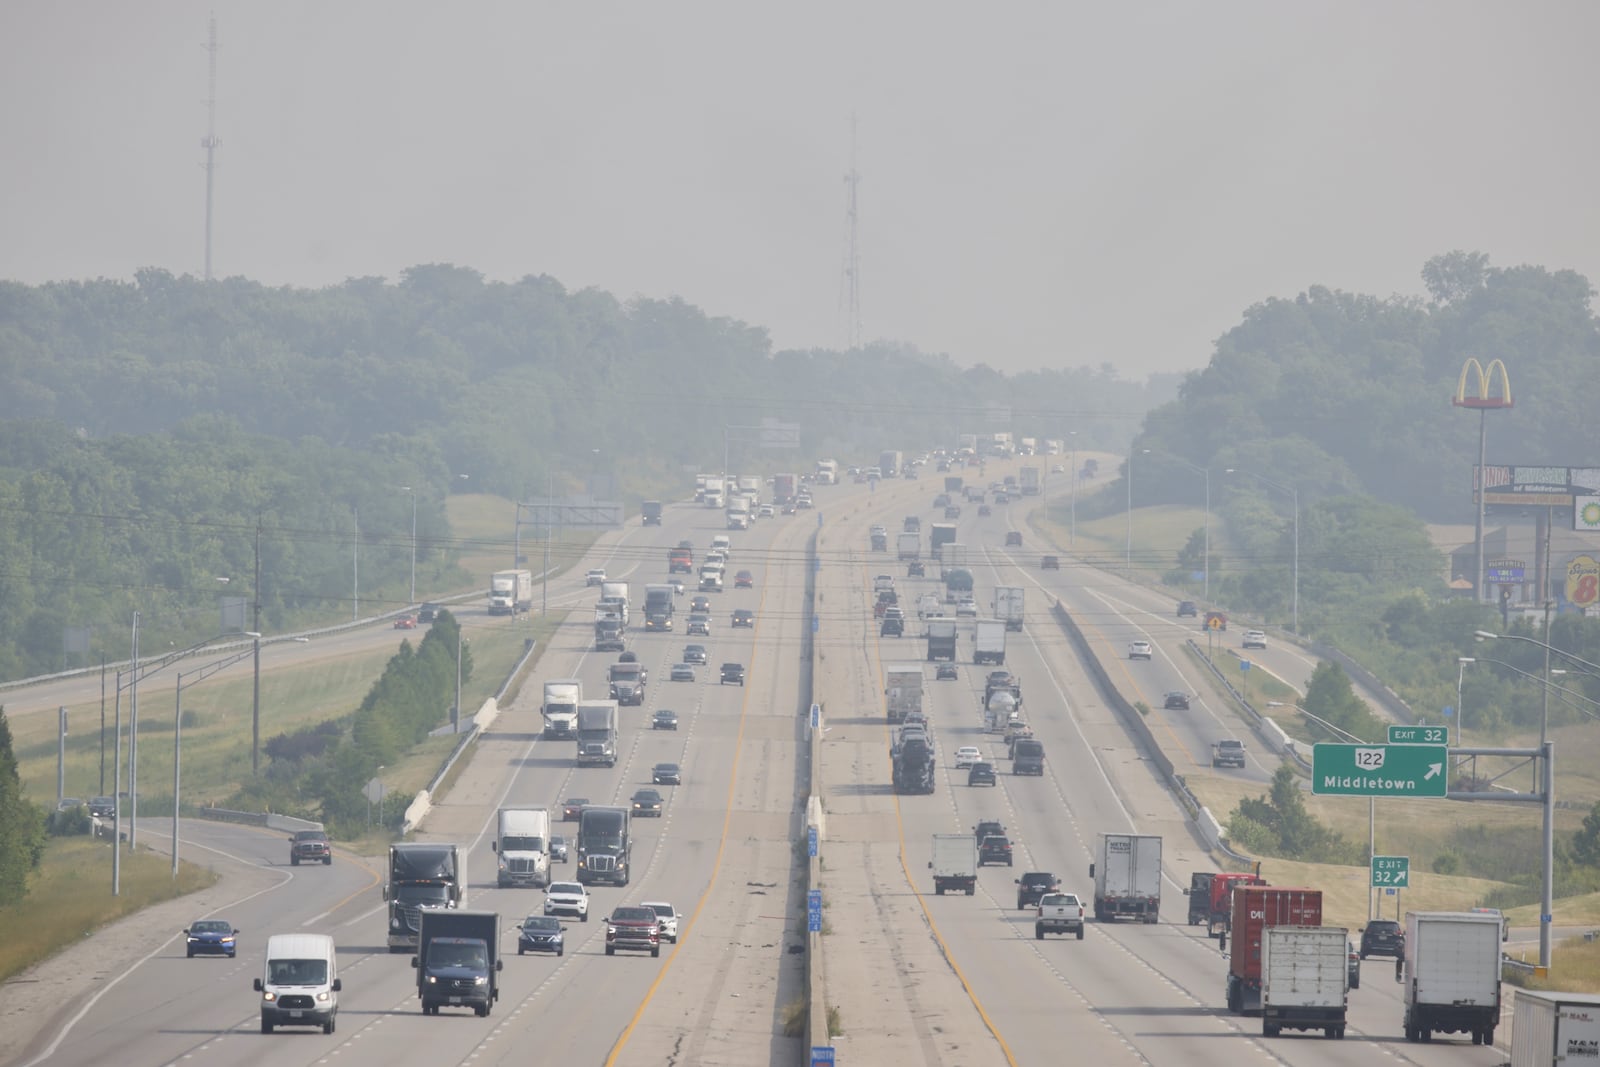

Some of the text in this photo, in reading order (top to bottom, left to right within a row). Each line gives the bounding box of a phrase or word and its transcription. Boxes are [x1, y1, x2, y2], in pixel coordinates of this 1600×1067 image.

[1569, 563, 1598, 580] Super
[1574, 576, 1598, 603] 8
[1395, 730, 1442, 742] EXIT 32
[1357, 752, 1383, 766] 122
[1324, 775, 1416, 790] Middletown
[1379, 860, 1402, 869] EXIT
[1375, 870, 1392, 883] 32
